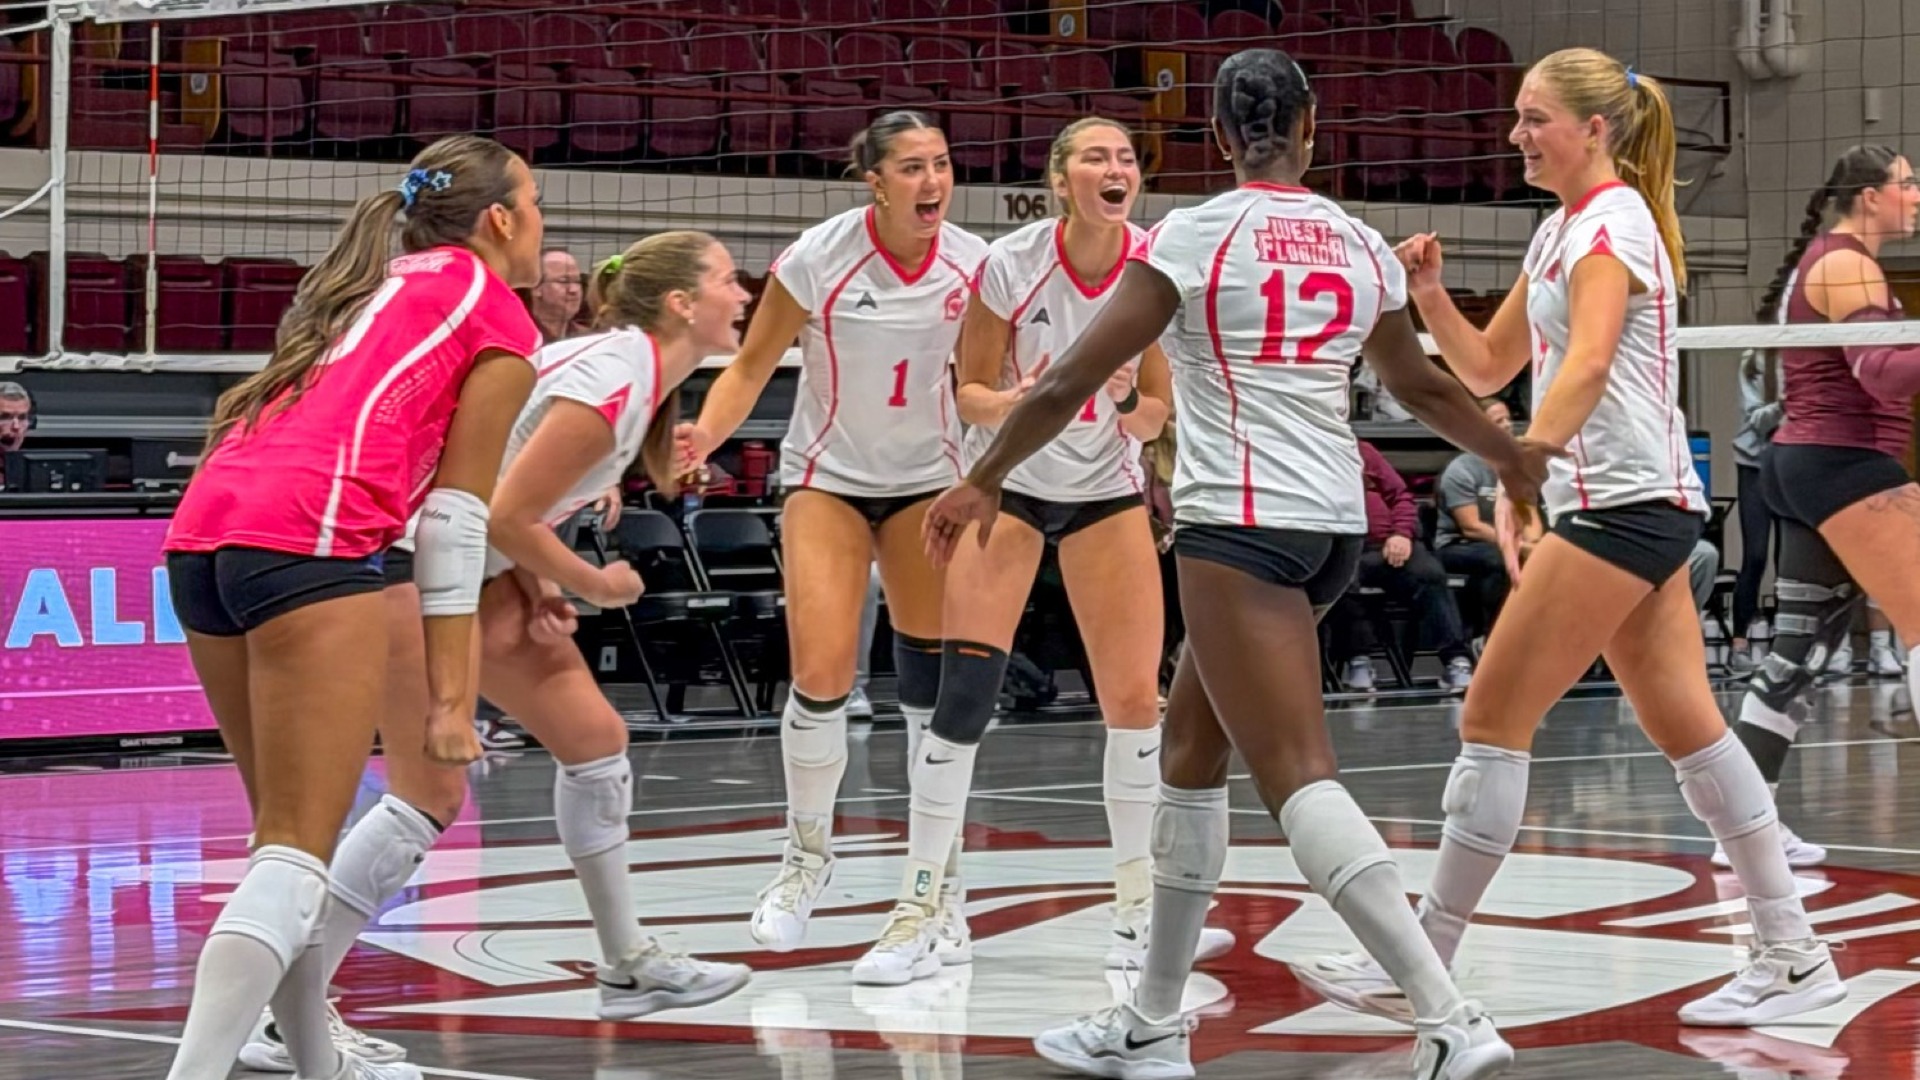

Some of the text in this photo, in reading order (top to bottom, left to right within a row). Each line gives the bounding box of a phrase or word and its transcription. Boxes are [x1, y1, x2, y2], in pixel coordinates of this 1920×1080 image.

[1003, 193, 1047, 220] 106
[1256, 230, 1348, 266] FLORIDA
[1269, 217, 1330, 243] WEST
[1253, 269, 1354, 364] 12
[888, 359, 908, 406] 1
